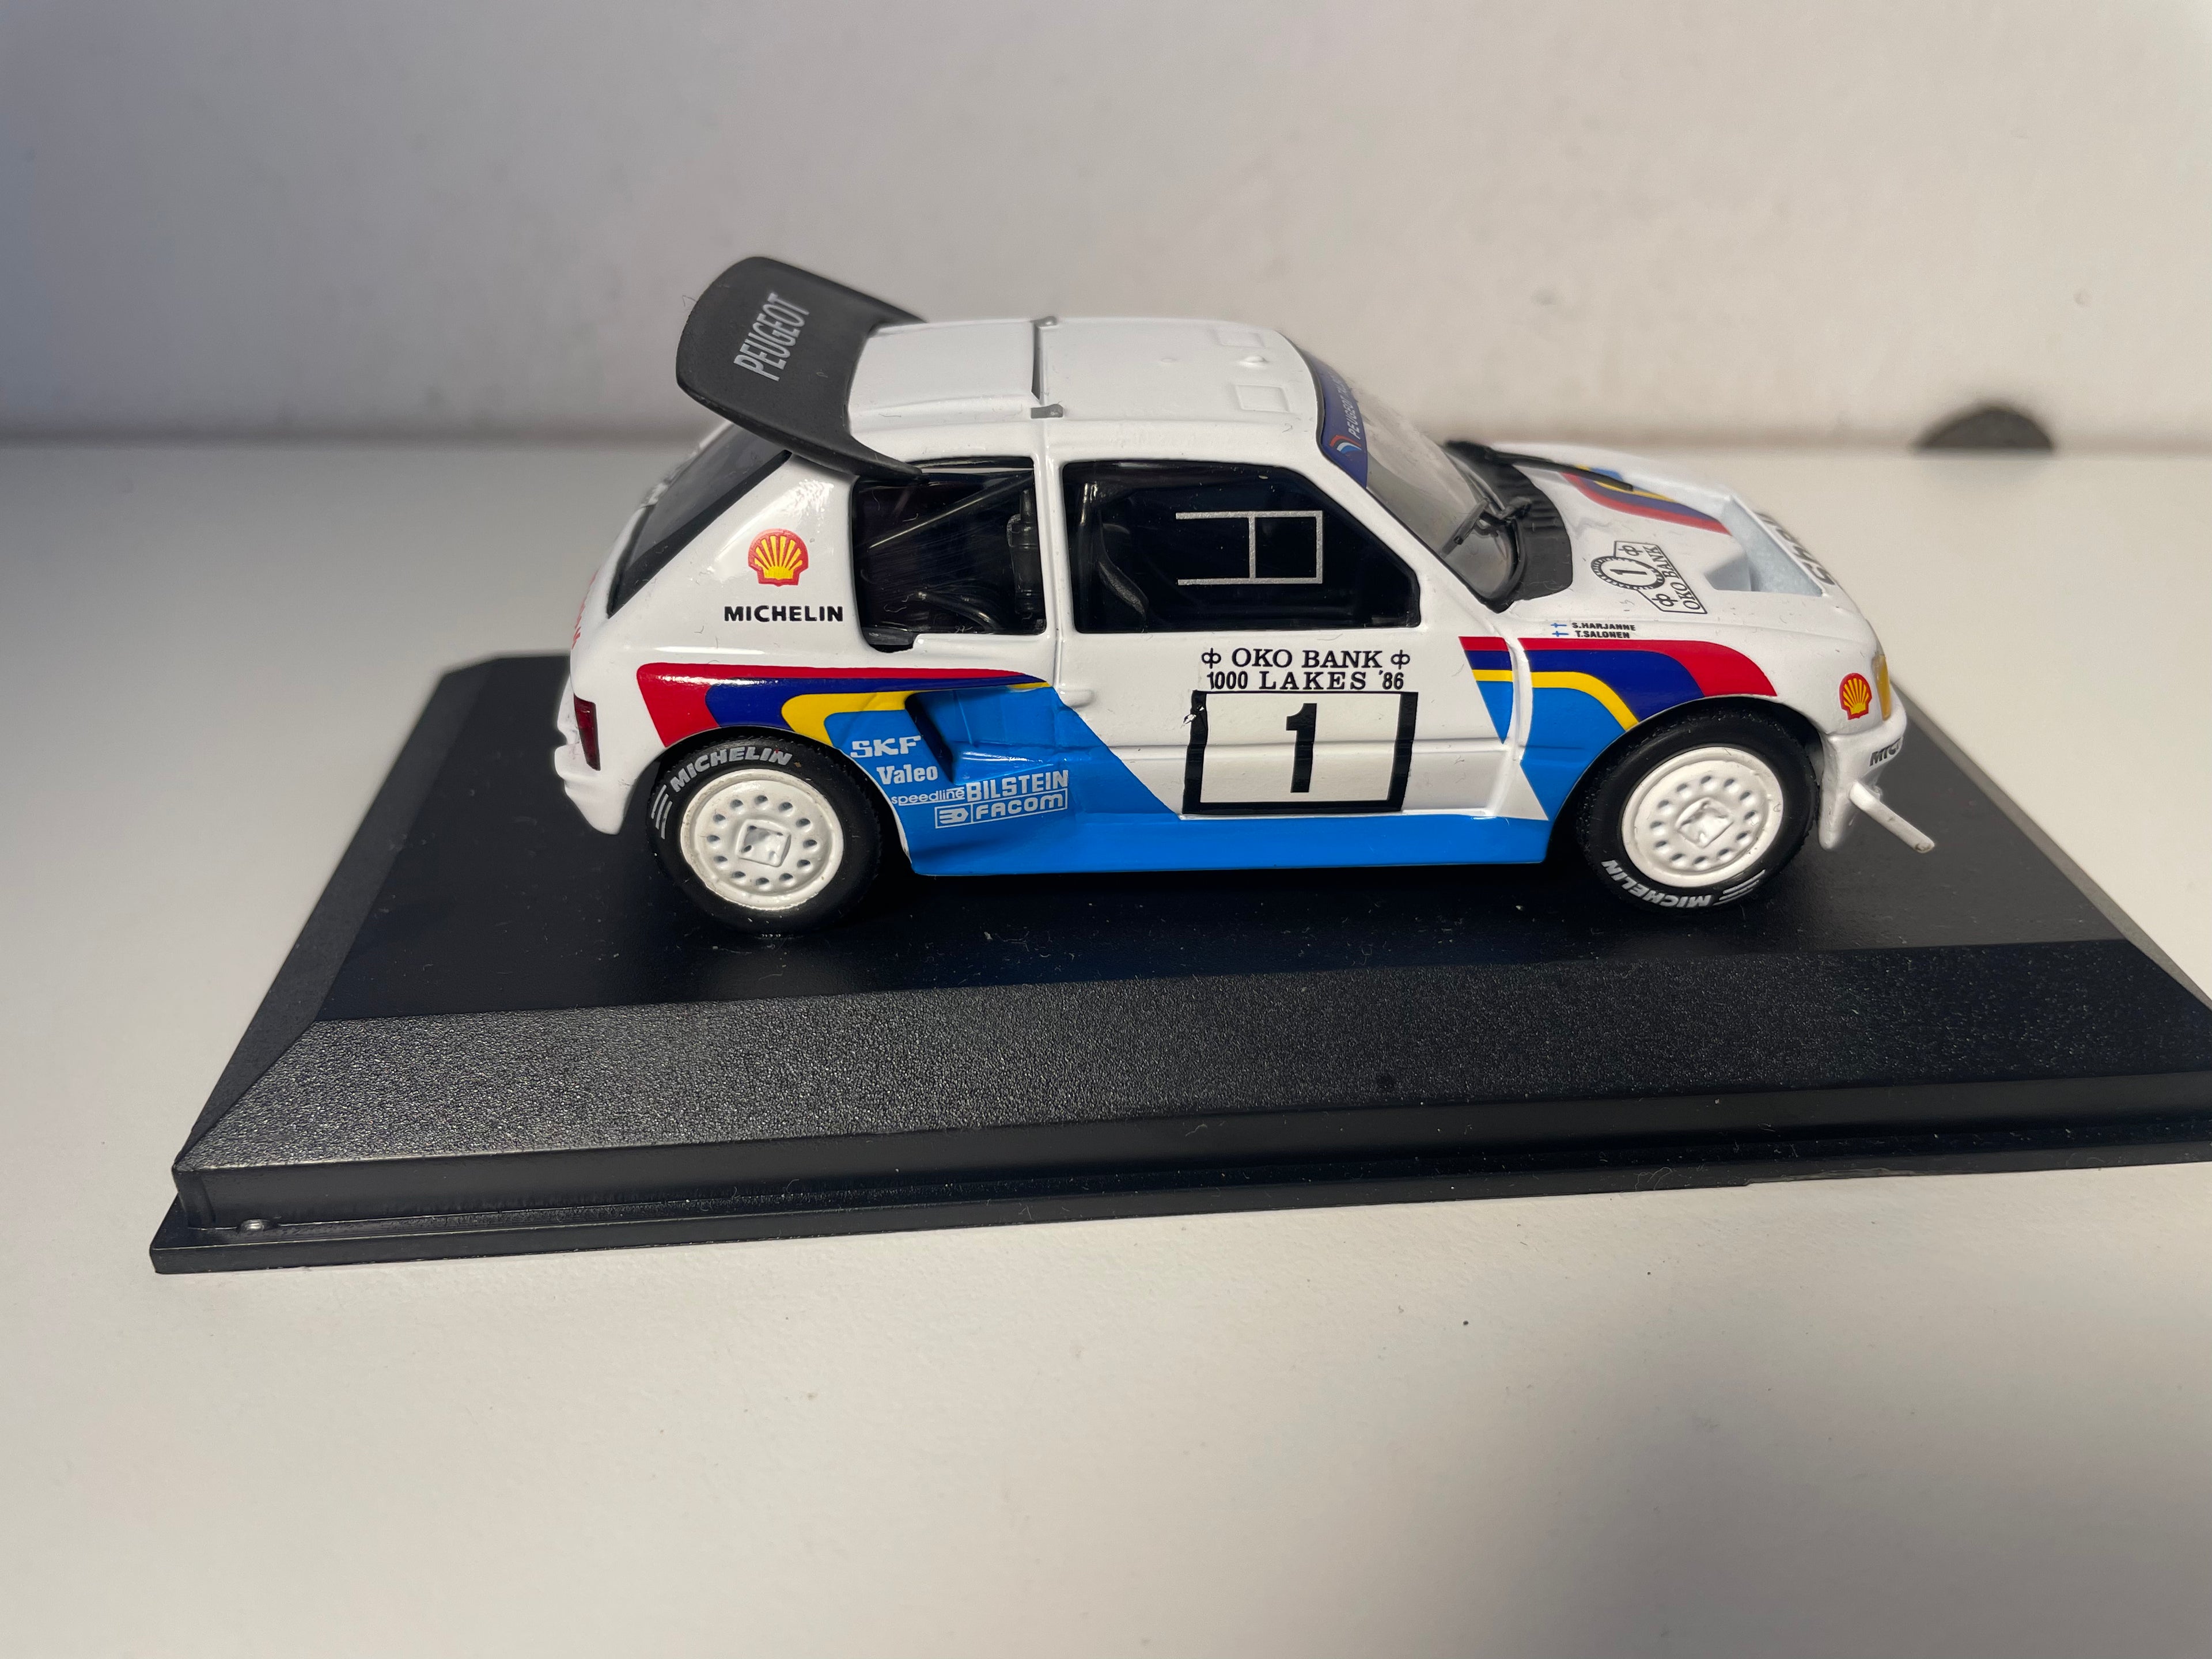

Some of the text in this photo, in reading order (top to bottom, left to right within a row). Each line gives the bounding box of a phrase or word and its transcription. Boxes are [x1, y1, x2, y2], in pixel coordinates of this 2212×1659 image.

[733, 293, 809, 382] PEUGEOT
[1643, 546, 1700, 609] OKO BANK
[724, 605, 843, 622] MICHELIN
[1571, 622, 1636, 631] S.HARJANNE
[1575, 630, 1630, 638] T.SALONEN
[1232, 647, 1382, 669] OKO BANK
[1207, 671, 1248, 690] 1000
[1259, 671, 1366, 690] LAKES
[850, 736, 921, 758] SKF
[1286, 703, 1317, 793] 1
[670, 747, 793, 793] MICHELIN
[876, 764, 938, 785] Valeo
[891, 787, 965, 806] speedline
[966, 770, 1069, 802] BILSTEIN
[1601, 859, 1713, 908] MICHELIN
